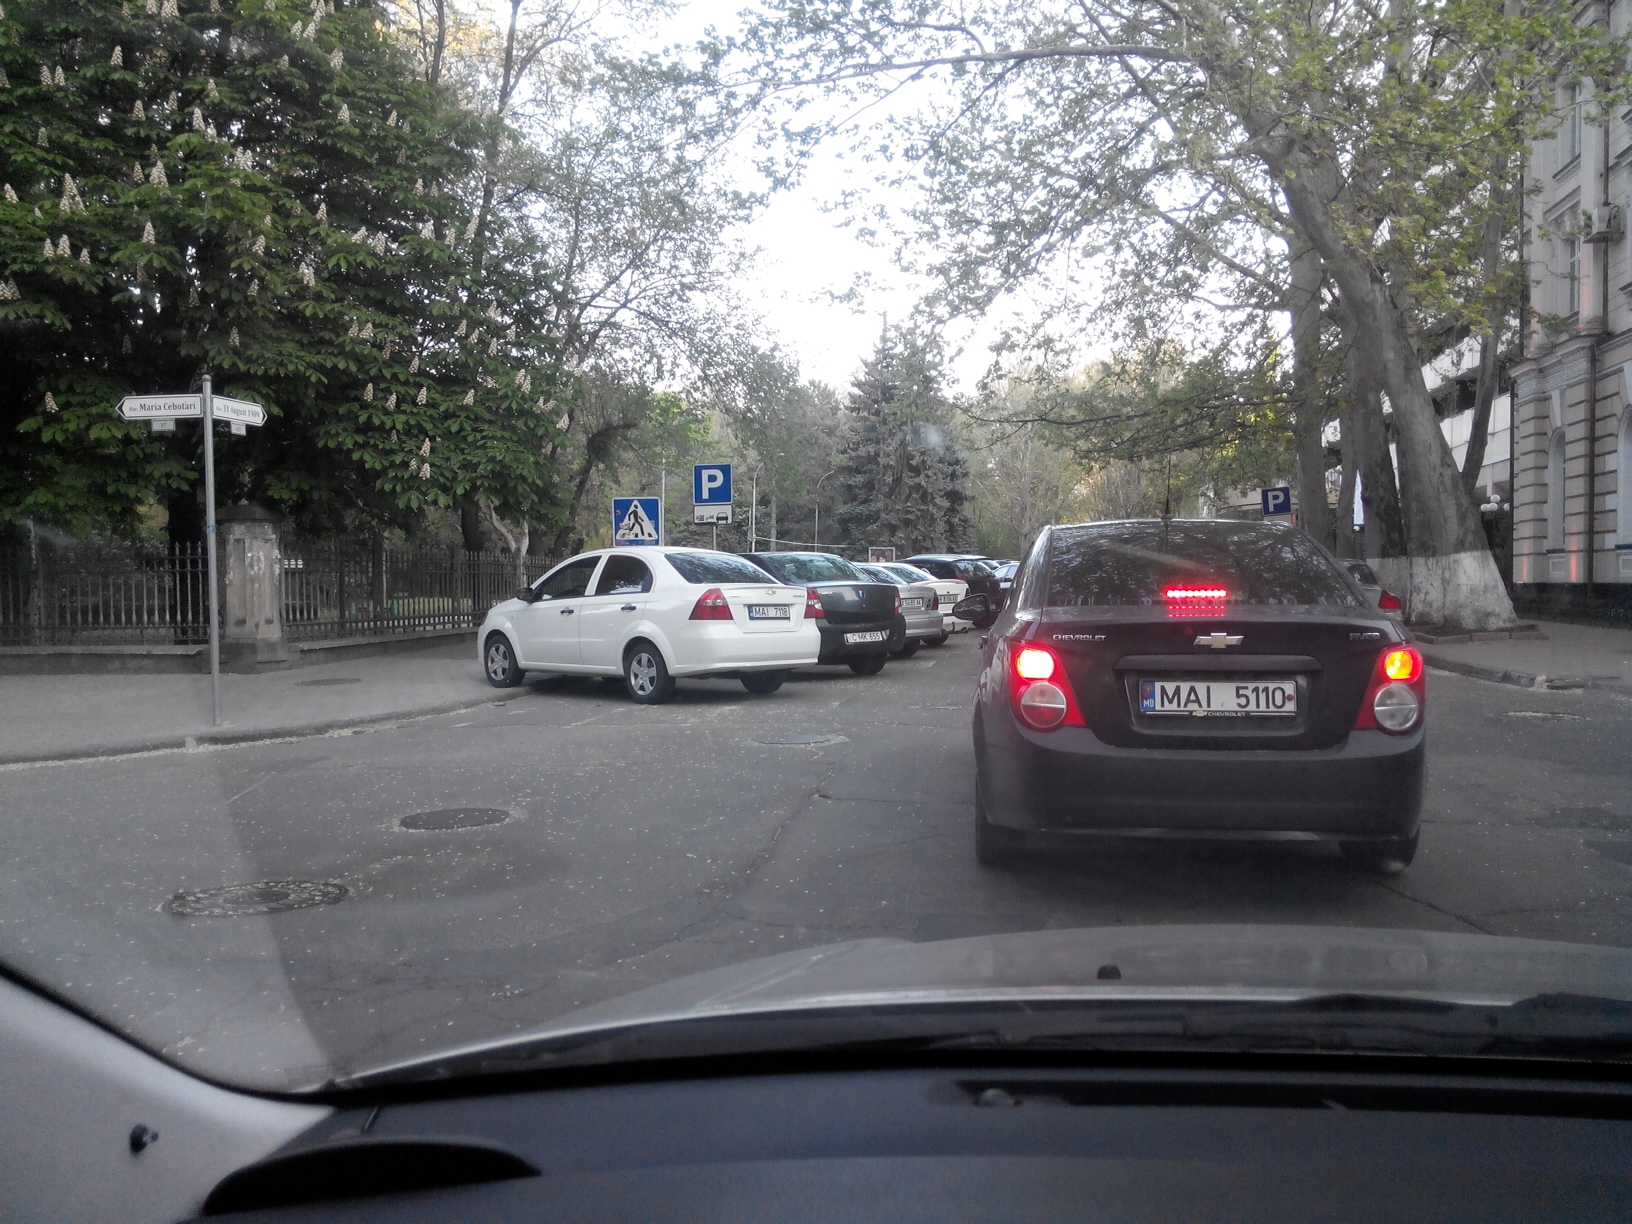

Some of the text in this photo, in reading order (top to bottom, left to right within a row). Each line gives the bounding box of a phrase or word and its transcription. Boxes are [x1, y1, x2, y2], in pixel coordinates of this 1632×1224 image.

[140, 403, 161, 412] Maria
[163, 401, 196, 411] Cebotari
[223, 404, 229, 413] 31
[702, 469, 724, 499] P
[1267, 491, 1285, 512] P
[754, 607, 788, 617] MAI 7118
[1160, 685, 1287, 709] MAI 5110
[1143, 698, 1155, 708] MD
